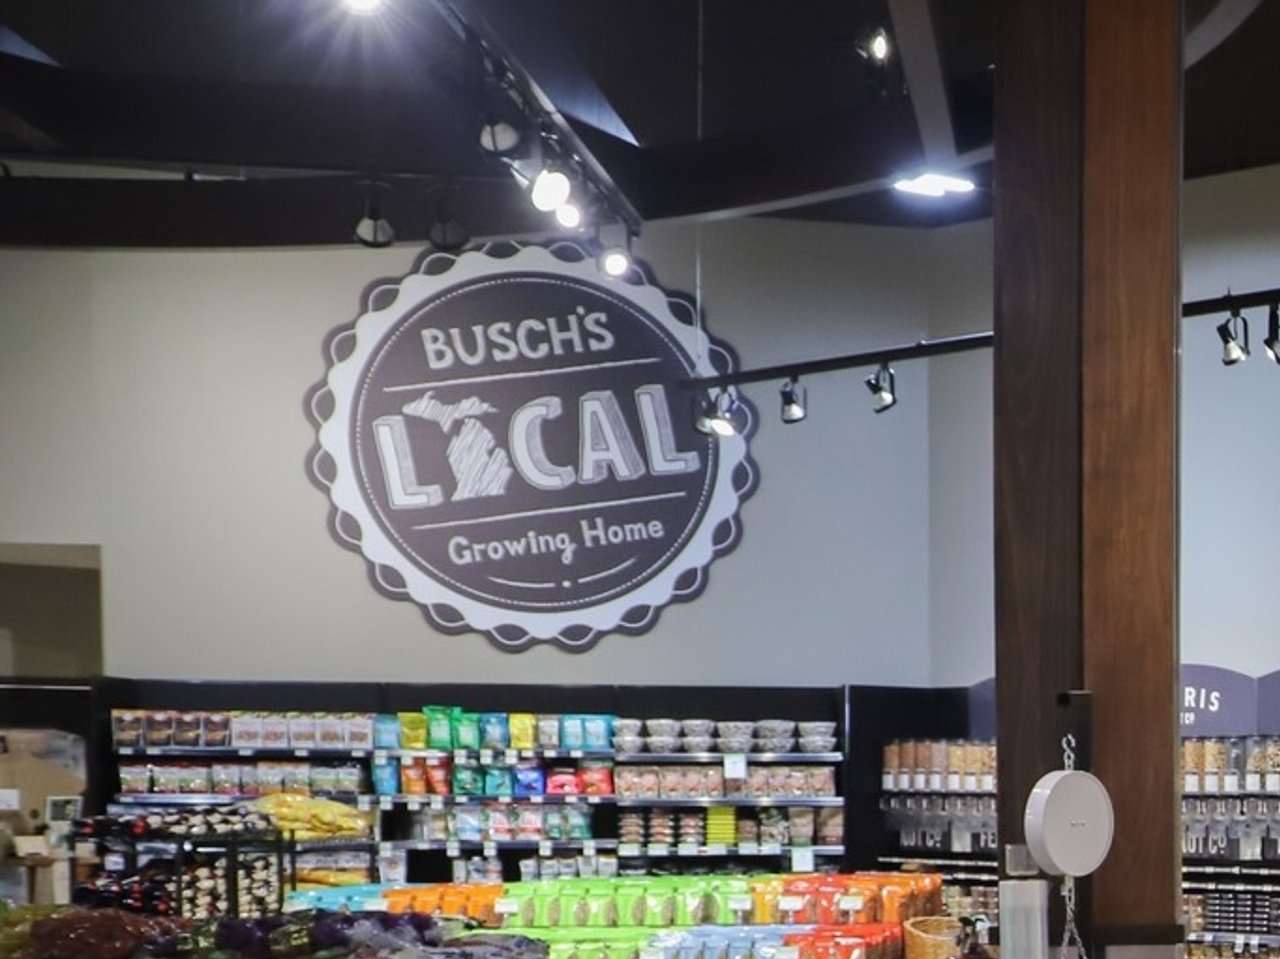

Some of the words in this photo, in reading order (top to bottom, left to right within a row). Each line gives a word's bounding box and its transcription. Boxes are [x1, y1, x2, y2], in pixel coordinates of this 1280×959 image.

[420, 306, 616, 370] BUSCH'S
[373, 384, 700, 510] LCAL
[448, 529, 578, 567] Growing
[581, 517, 666, 548] Home
